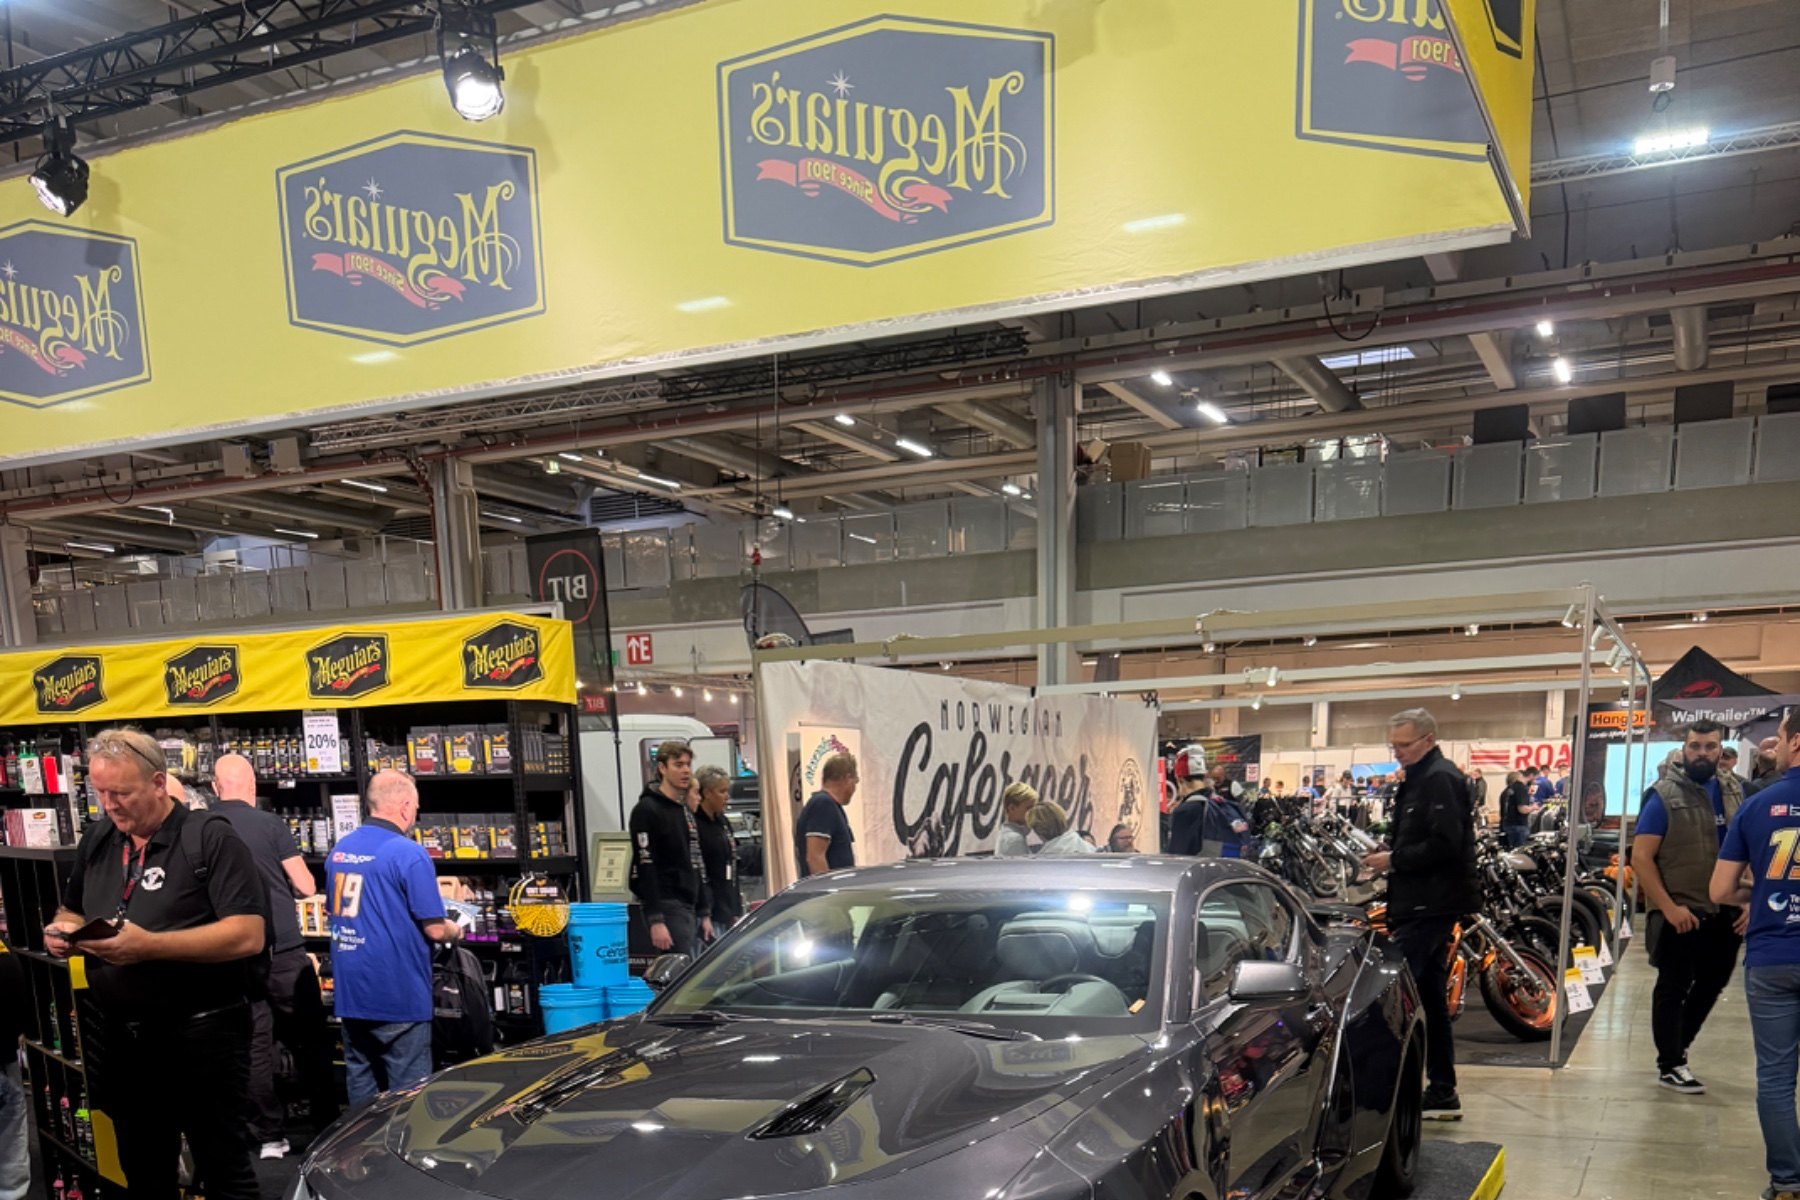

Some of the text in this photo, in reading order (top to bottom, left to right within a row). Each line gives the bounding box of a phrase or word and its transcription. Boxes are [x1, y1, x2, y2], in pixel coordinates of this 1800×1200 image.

[313, 639, 382, 690] Meguiar's
[467, 631, 536, 681] Meguiar's
[640, 636, 651, 661] E
[36, 660, 97, 707] Meguiar's
[169, 650, 233, 699] Meguiar's
[308, 734, 337, 749] 20%
[940, 699, 1062, 737] NORWEGIAN
[333, 872, 363, 919] 19
